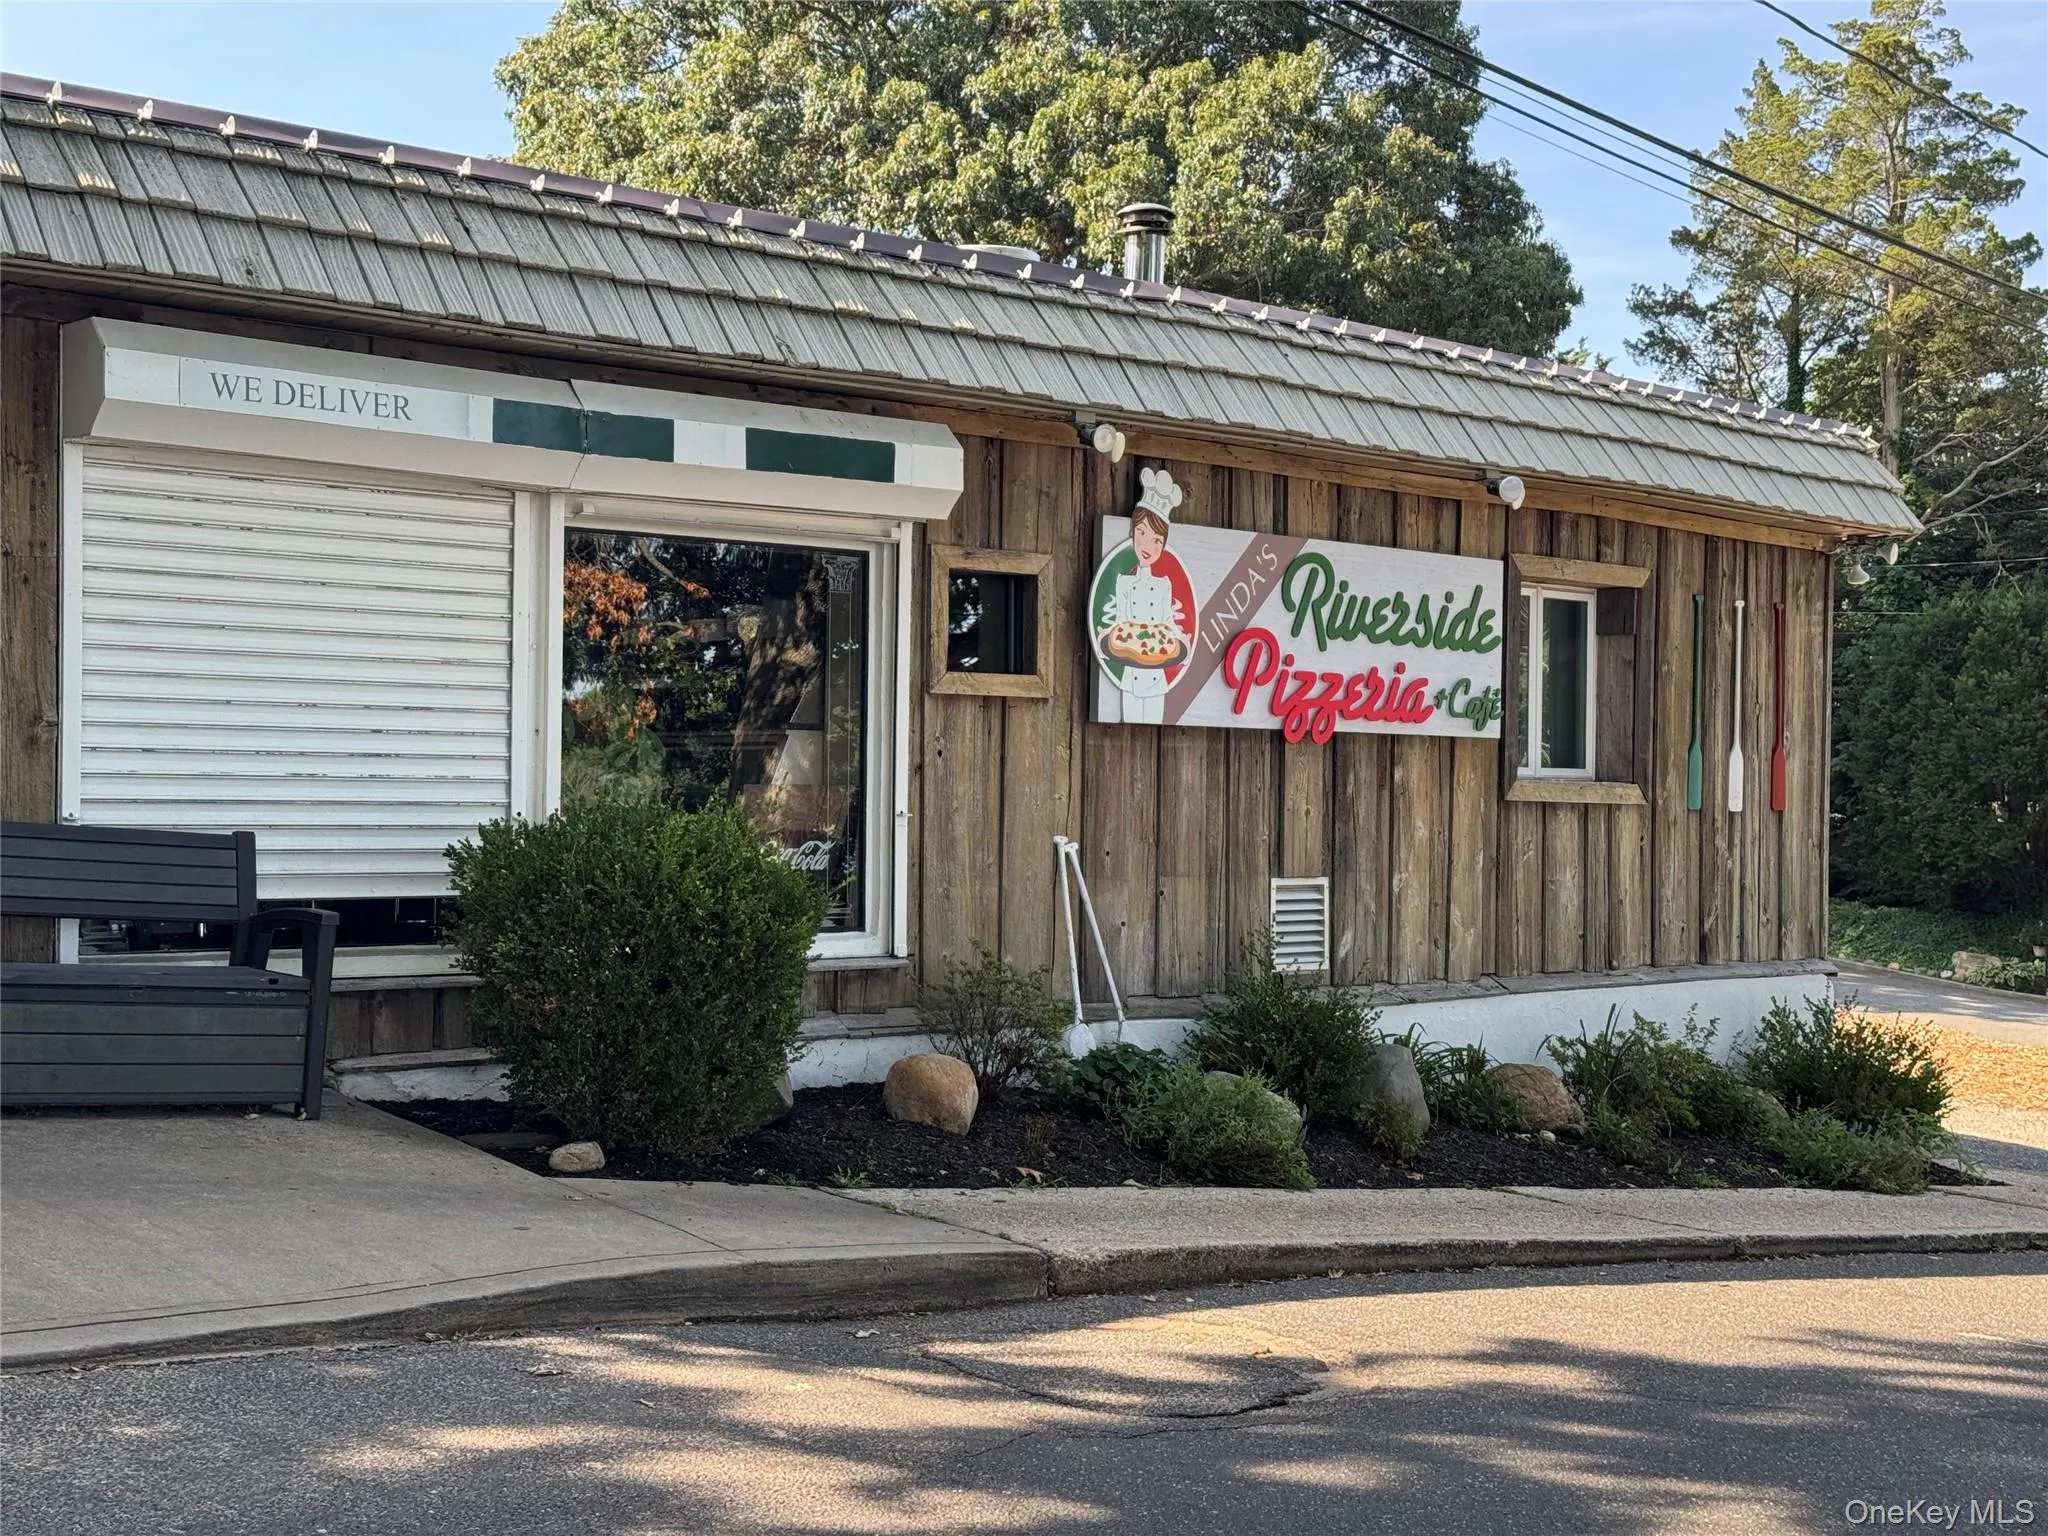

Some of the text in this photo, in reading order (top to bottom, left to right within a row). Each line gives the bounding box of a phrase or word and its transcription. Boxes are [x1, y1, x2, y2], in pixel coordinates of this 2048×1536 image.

[209, 372, 413, 421] WE DELIVER
[1201, 543, 1278, 654] LINDA'S
[1281, 552, 1502, 652] Riverside
[1223, 627, 1434, 745] Pizzeria
